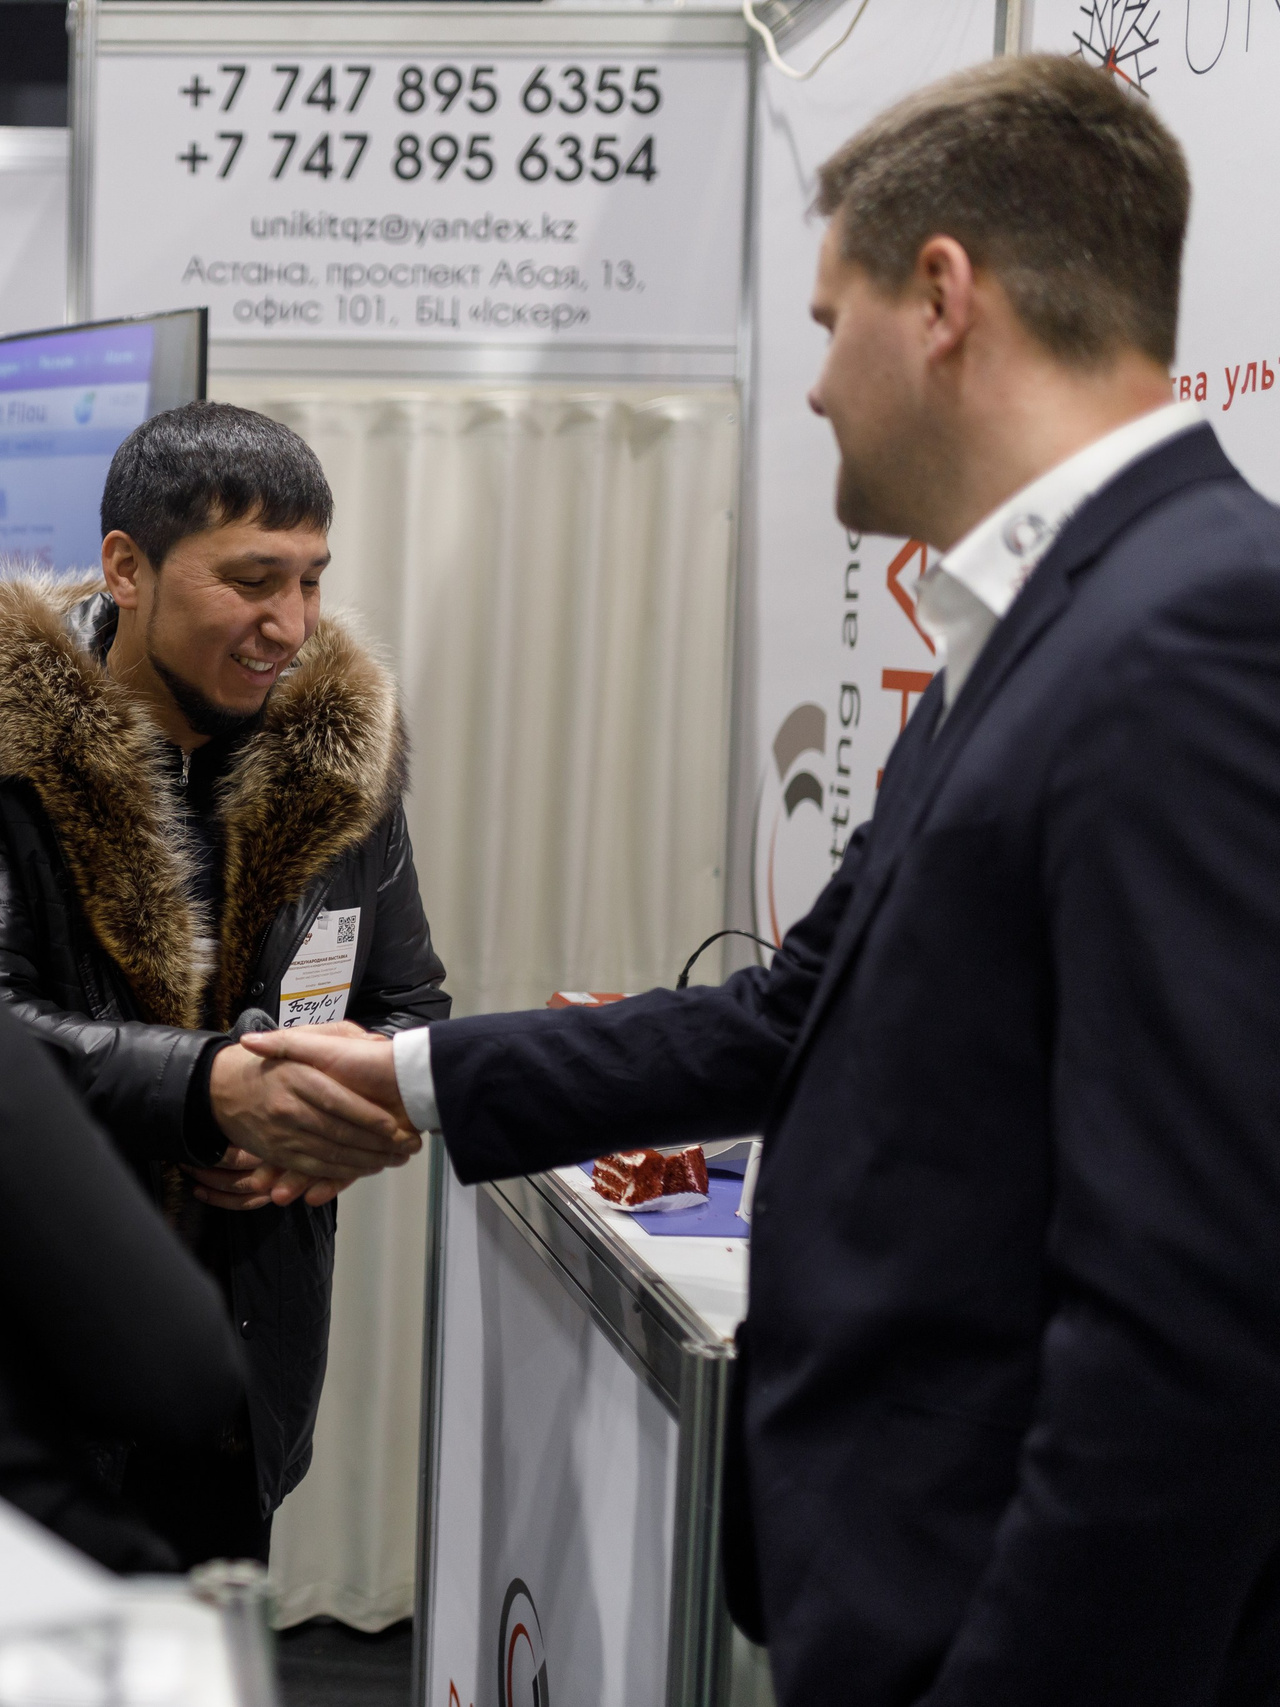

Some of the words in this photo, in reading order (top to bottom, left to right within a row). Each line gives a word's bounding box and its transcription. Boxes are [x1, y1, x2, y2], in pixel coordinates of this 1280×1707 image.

[180, 65, 248, 113] +7
[274, 66, 372, 113] 747
[395, 66, 499, 115] 895
[521, 66, 662, 116] 6355
[177, 132, 245, 180] +7
[270, 133, 369, 180] 747
[392, 134, 495, 183] 895
[517, 134, 658, 184] 6354
[250, 211, 578, 246] unikitqz@yandex.kz
[325, 262, 482, 291] проспект
[232, 294, 321, 327] офис
[336, 294, 399, 326] 101,
[415, 296, 461, 329] БЦ
[1171, 371, 1208, 402] ва
[1222, 356, 1280, 411] уль
